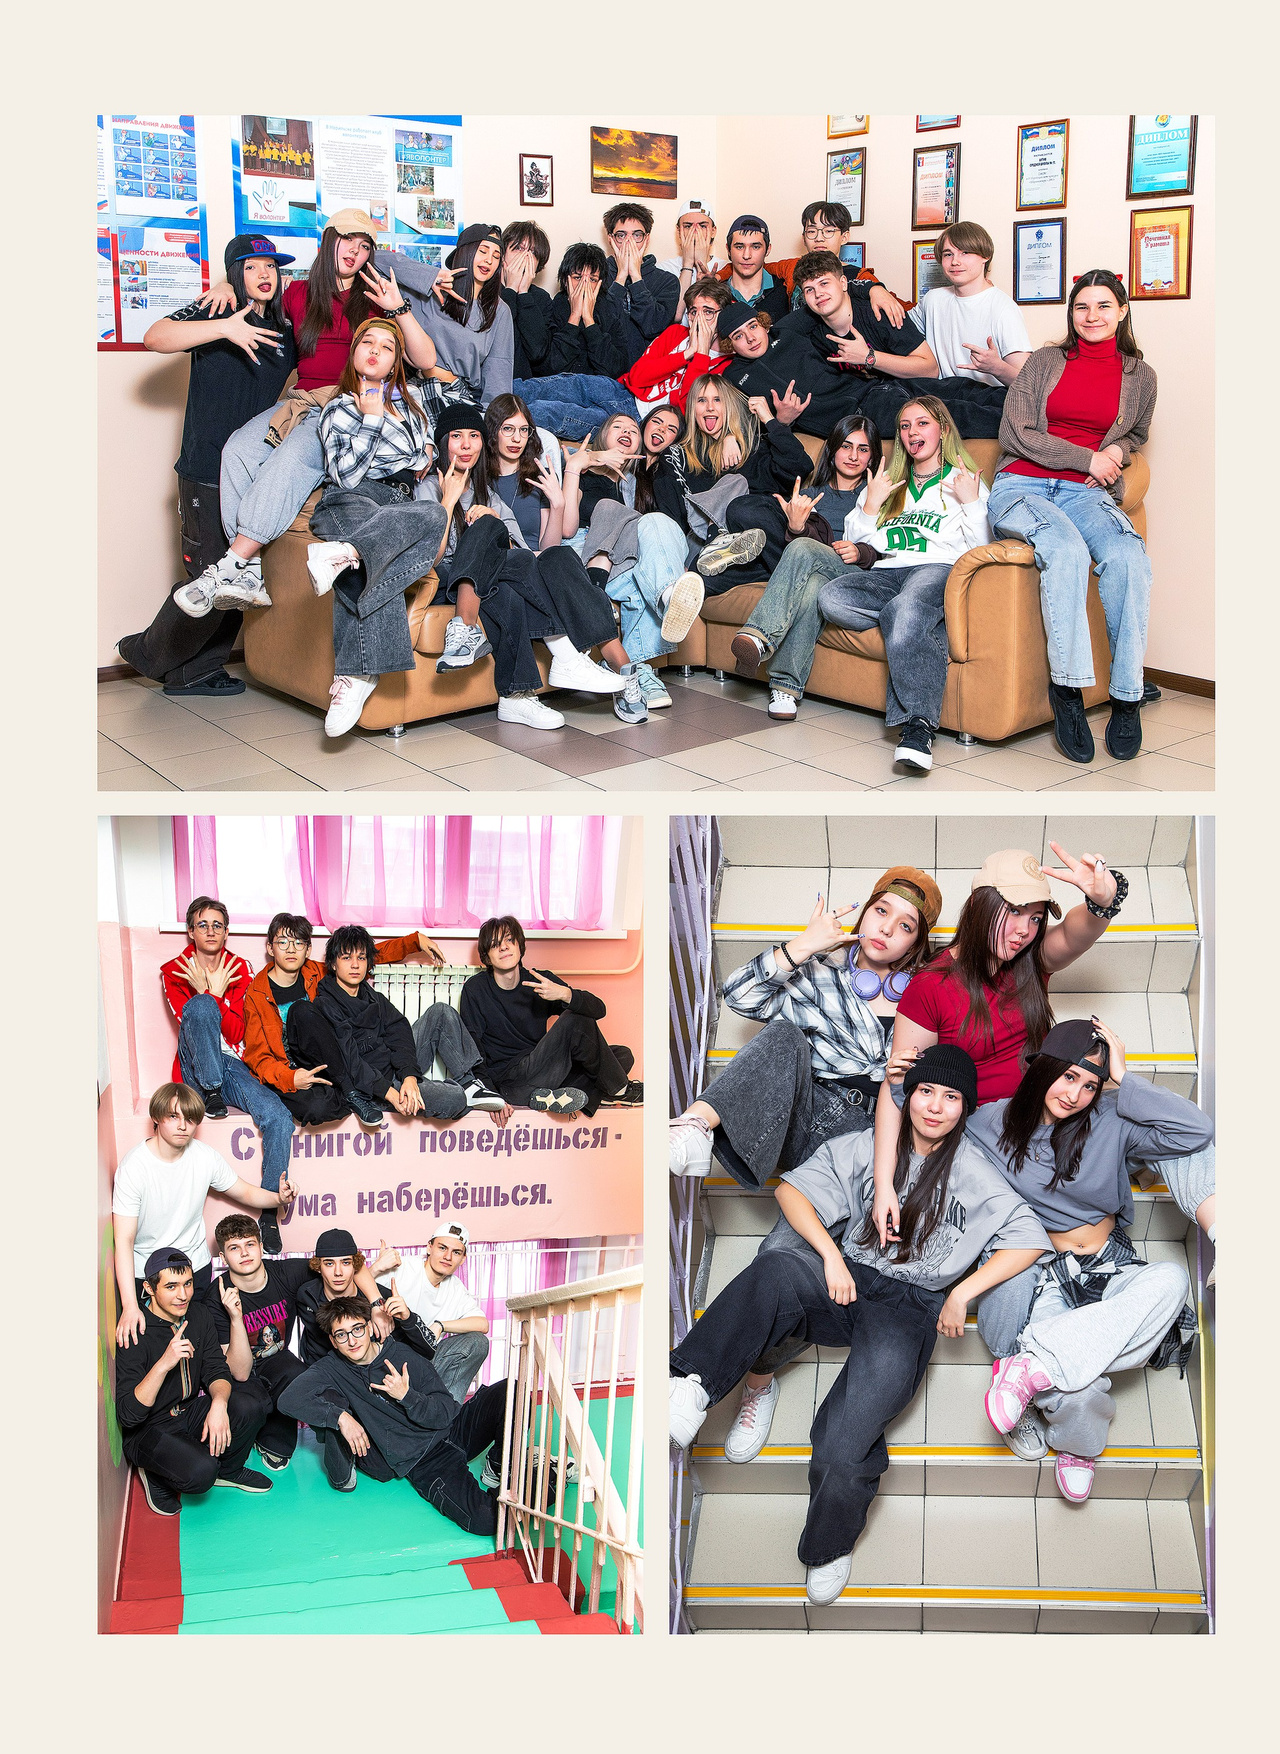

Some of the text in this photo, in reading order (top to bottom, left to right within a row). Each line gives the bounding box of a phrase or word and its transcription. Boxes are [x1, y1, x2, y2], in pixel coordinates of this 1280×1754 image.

[112, 117, 195, 131] НАПРАВЛЕНИЯ ДВИЖЕНИЯ
[1137, 129, 1188, 145] ДИПЛОМ
[1031, 144, 1056, 152] ДИПЛОМ
[835, 177, 856, 186] ДИПЛОМ
[920, 172, 943, 180] ДИПЛОМ
[119, 249, 159, 257] ЦЕННОСТИ
[1027, 242, 1053, 250] ДИПЛОМ
[877, 513, 941, 533] LIFORNIA
[884, 526, 928, 553] 95
[292, 1122, 392, 1158] нигой
[357, 1181, 552, 1218] наберёшься.
[242, 1299, 289, 1334] RESSURE
